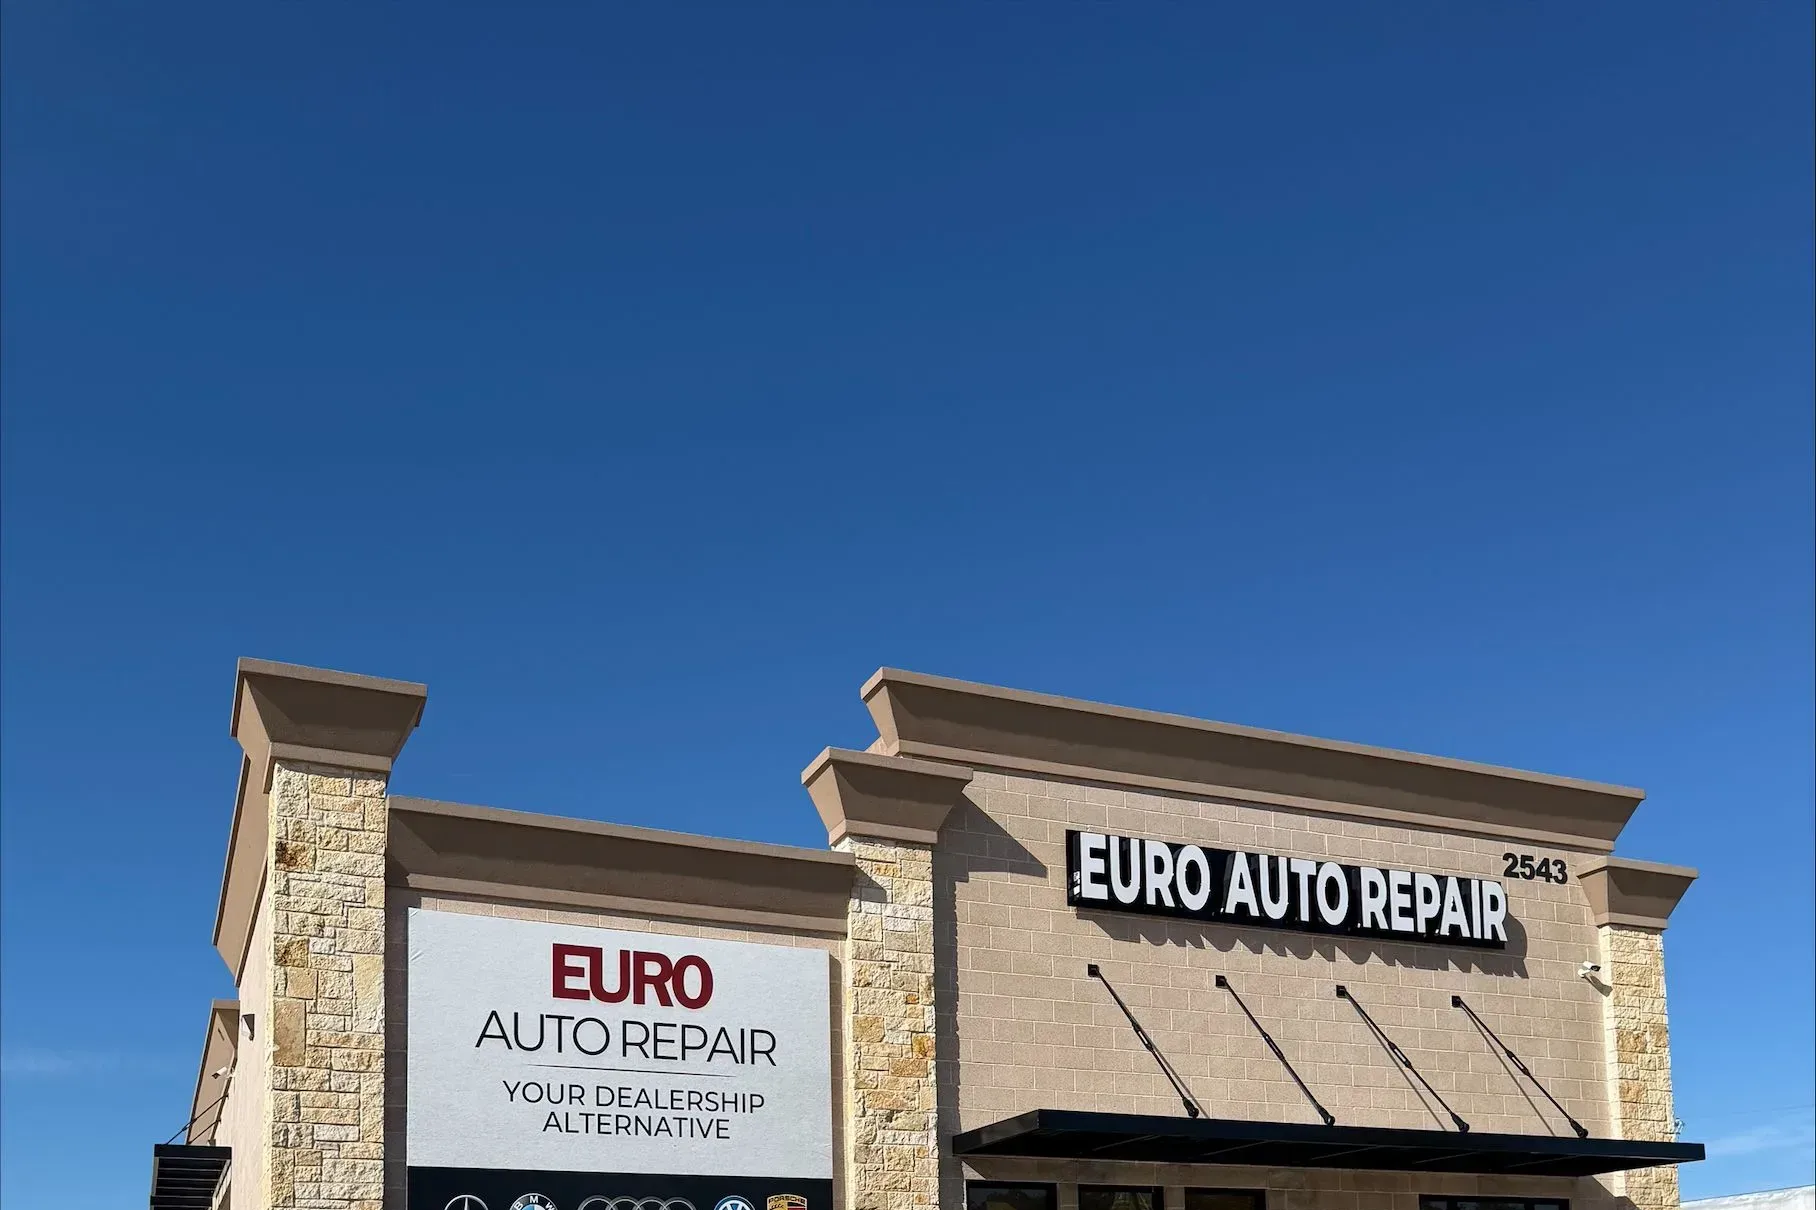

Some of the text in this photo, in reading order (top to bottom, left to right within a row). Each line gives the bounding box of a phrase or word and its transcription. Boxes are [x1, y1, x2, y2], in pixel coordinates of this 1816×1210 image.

[1502, 852, 1568, 885] 2543
[1079, 831, 1508, 942] EURO AUTO REPAIR
[551, 943, 714, 1010] EURO
[475, 1010, 777, 1067] AUTO REPAIR
[502, 1080, 765, 1114] YOUR DEALERSHIP
[542, 1111, 731, 1140] ALTERNATIVE
[768, 1195, 806, 1205] PORSCHE
